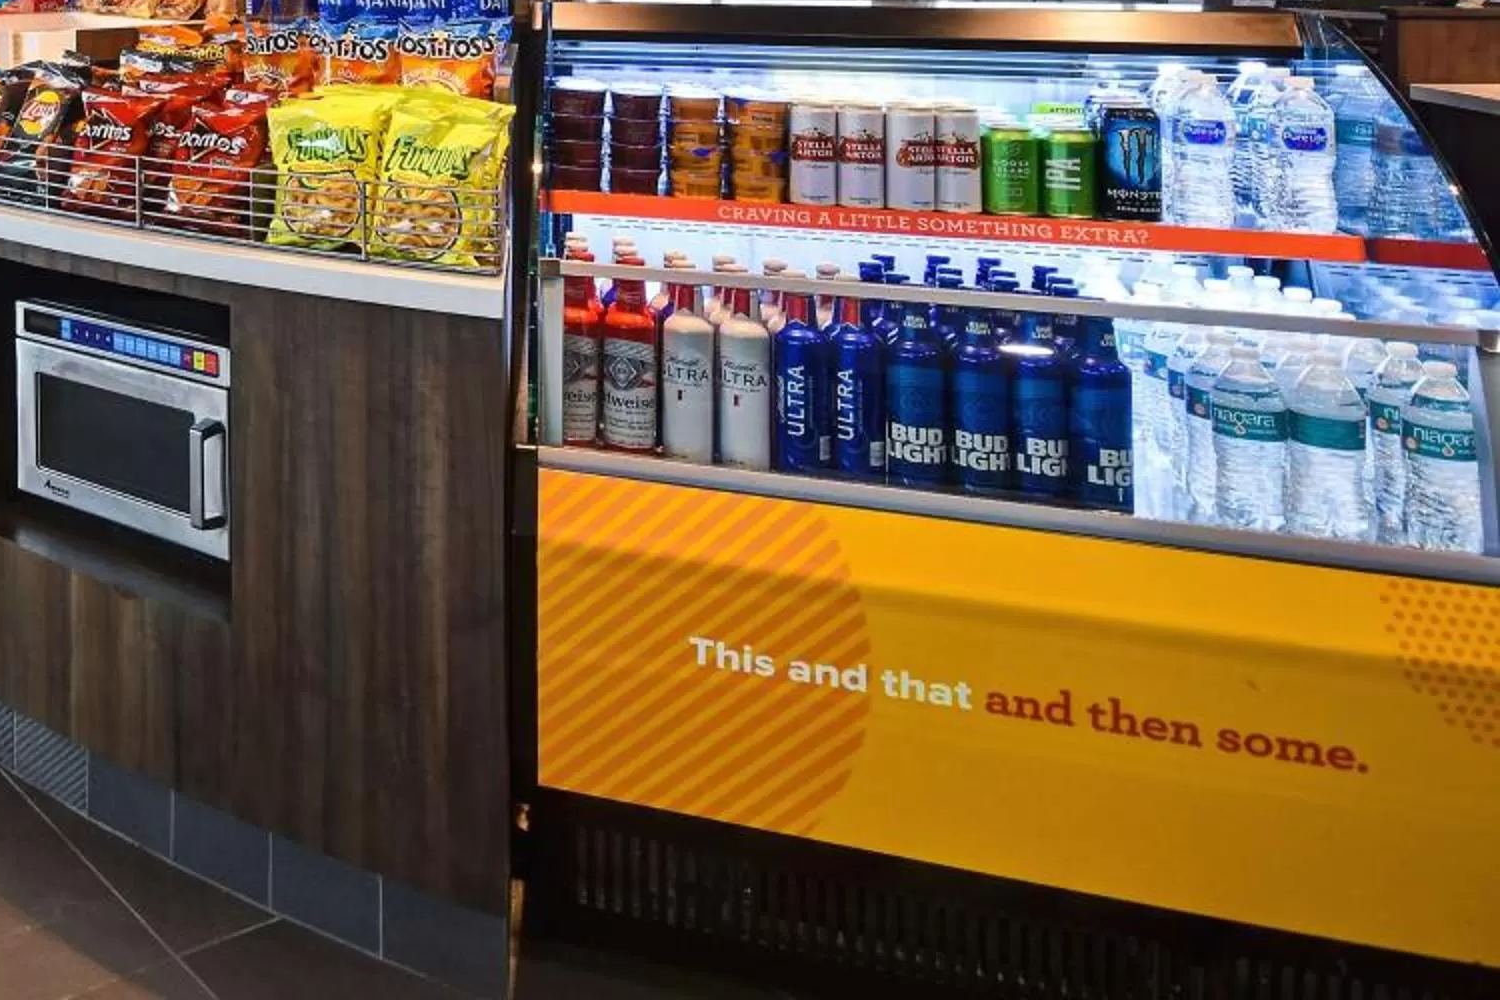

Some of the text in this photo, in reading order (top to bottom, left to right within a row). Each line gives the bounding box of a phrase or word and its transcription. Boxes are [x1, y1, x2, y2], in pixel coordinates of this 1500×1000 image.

[179, 130, 247, 155] Doritos
[1044, 157, 1082, 191] IPA
[1106, 187, 1162, 202] MONSTE
[718, 205, 1150, 245] CRAVING A LITTLE SOMETHING EXTRA?
[664, 364, 709, 381] LTRA
[722, 371, 768, 387] LTRA
[787, 365, 805, 437] ULTRA
[837, 369, 855, 441] ULTRA
[1213, 405, 1276, 434] niagara
[891, 422, 943, 445] BUD
[955, 430, 1008, 453] BUD
[1027, 437, 1068, 457] BU
[1100, 449, 1133, 467] BU
[1017, 453, 1067, 477] LIG
[1087, 465, 1132, 486] LIG
[689, 636, 1370, 774] This and that and then some.
